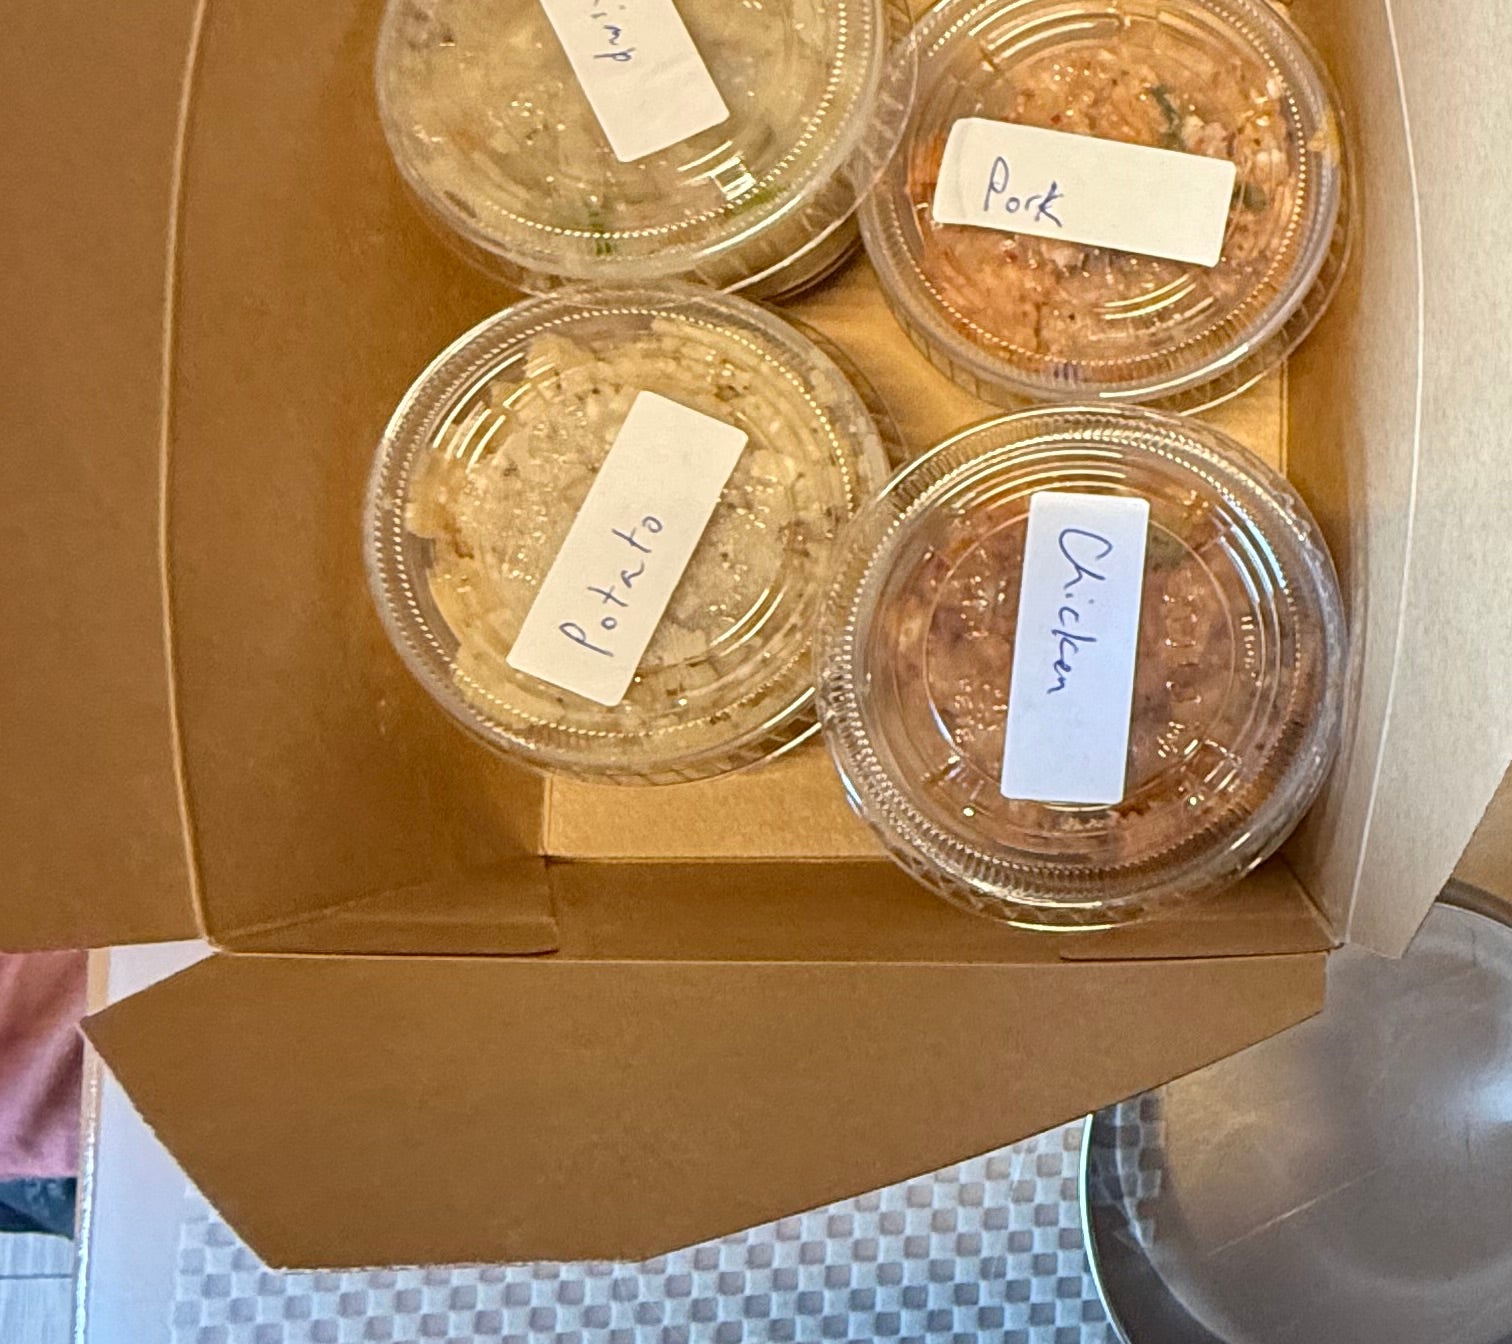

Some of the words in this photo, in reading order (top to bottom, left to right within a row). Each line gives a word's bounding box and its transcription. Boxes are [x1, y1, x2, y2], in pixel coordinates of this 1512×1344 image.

[984, 156, 1064, 227] Pork
[558, 515, 663, 657] Potato
[1047, 528, 1113, 694] Chicken
